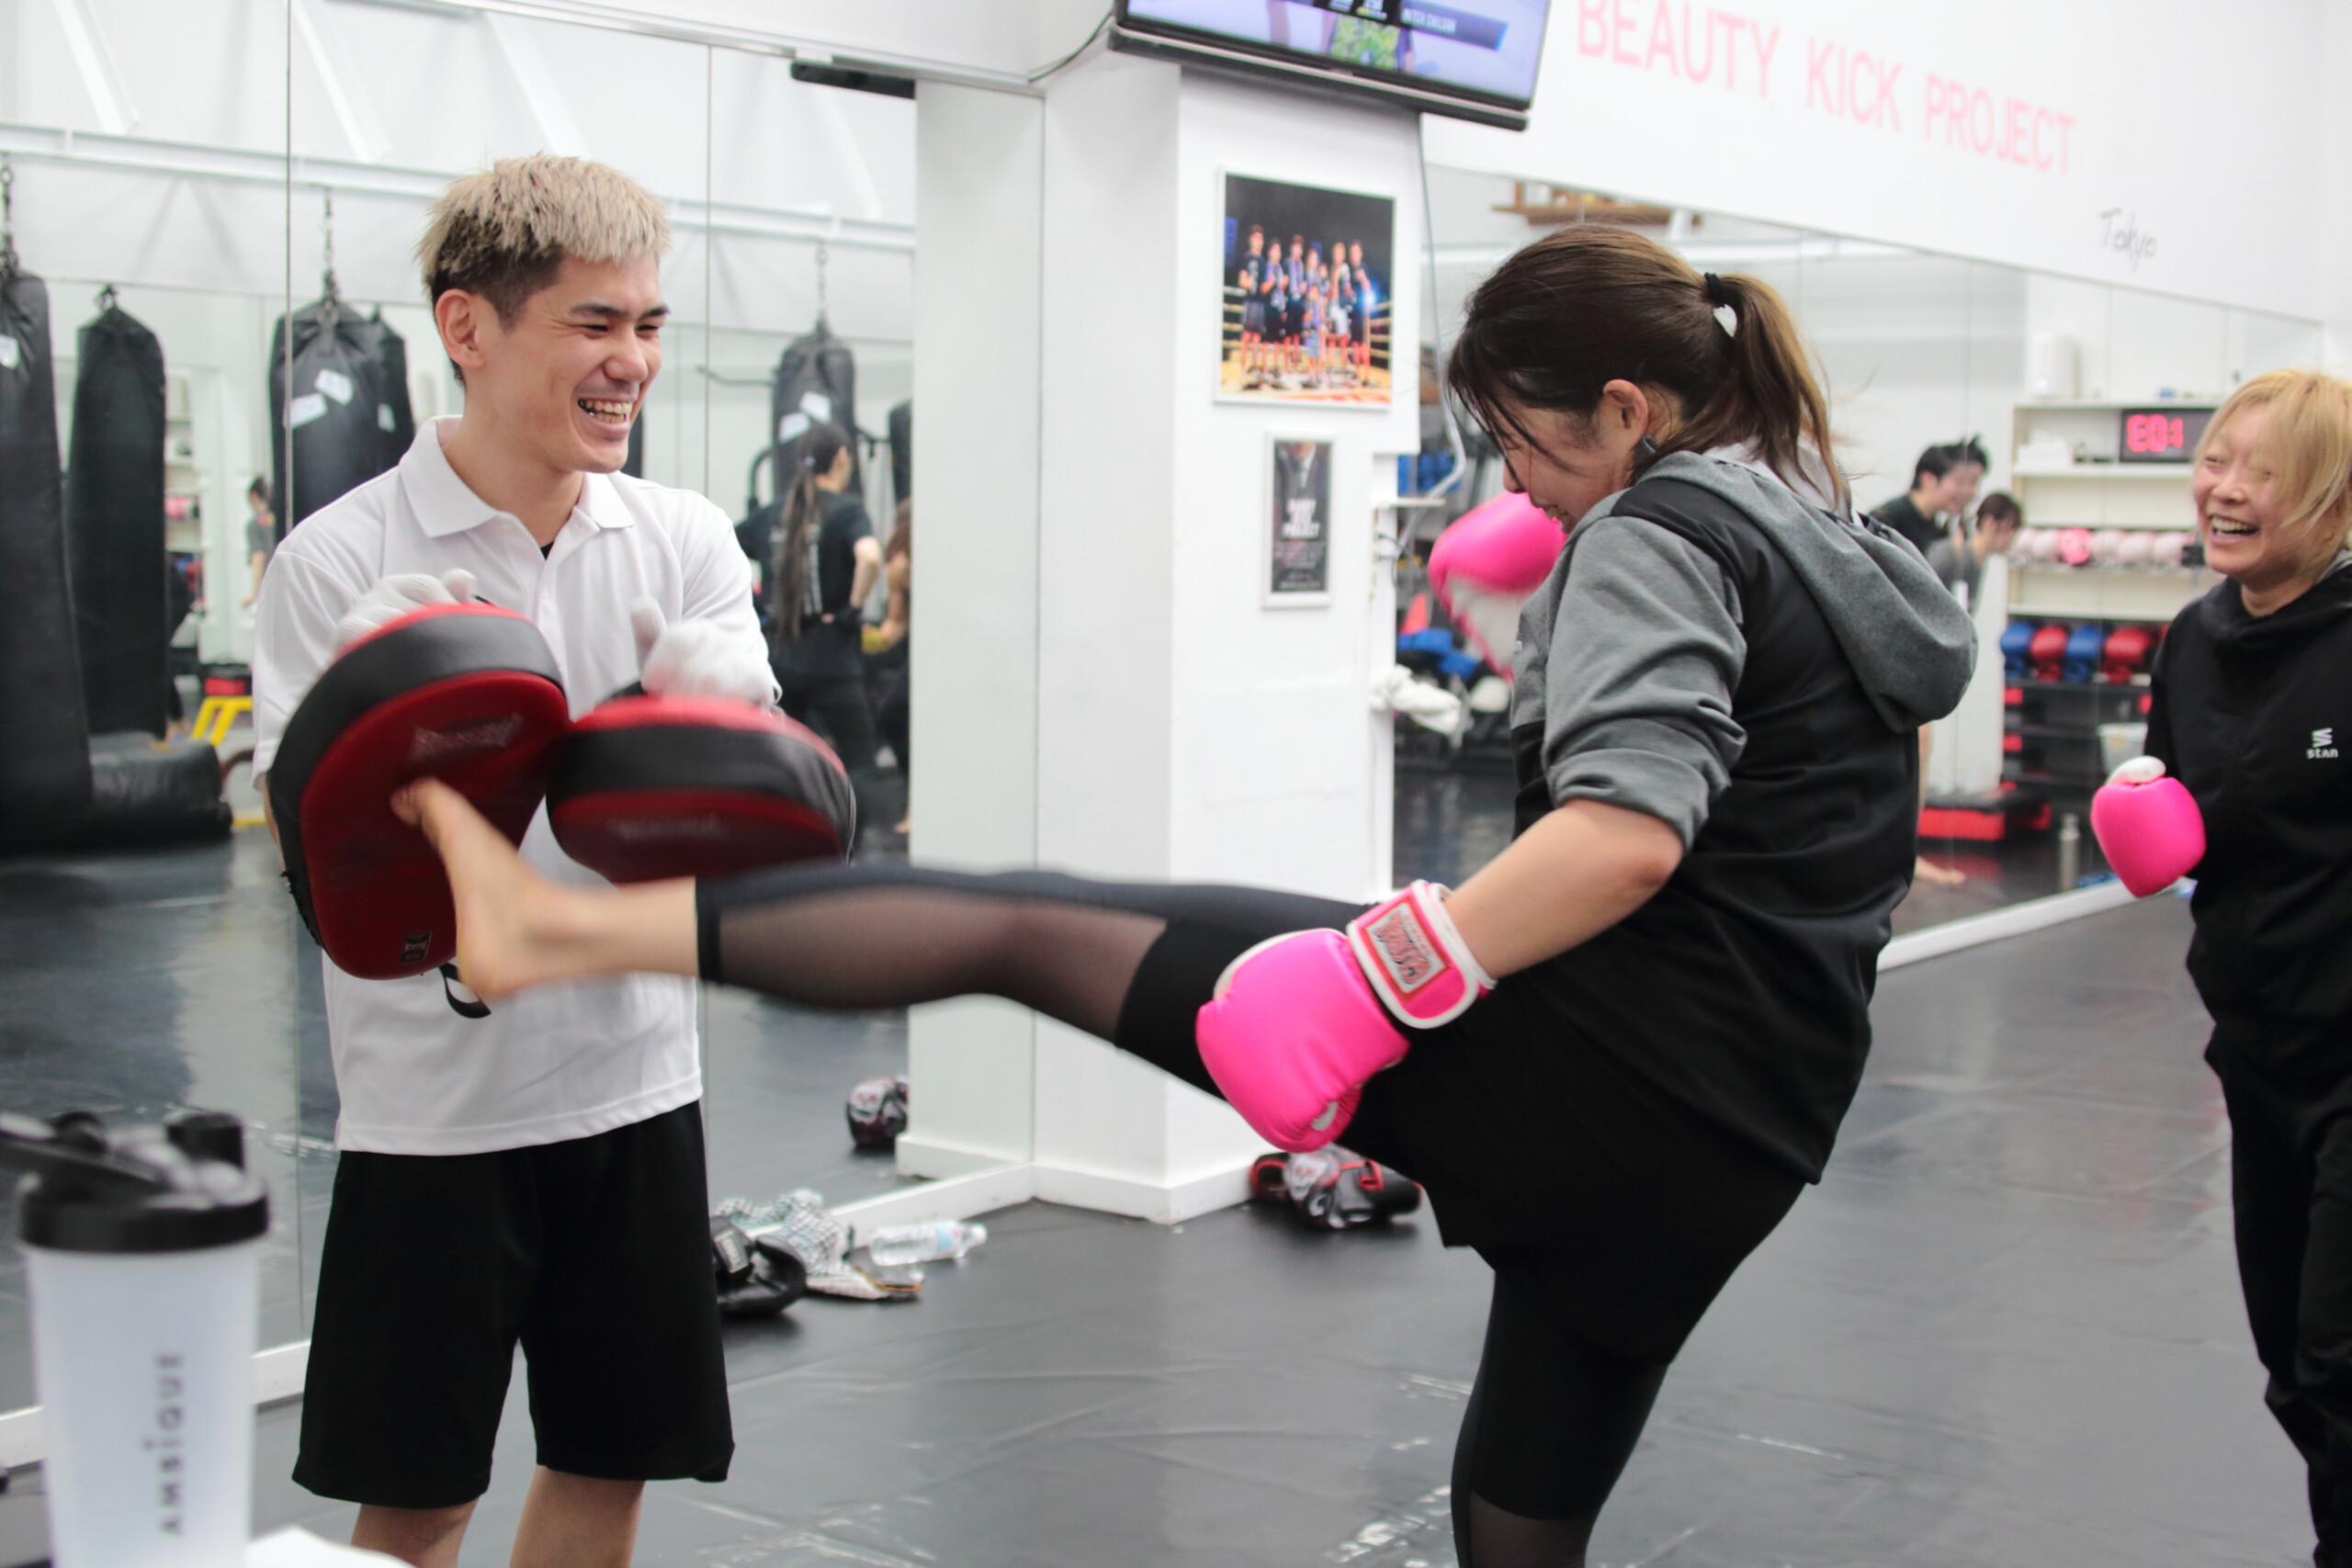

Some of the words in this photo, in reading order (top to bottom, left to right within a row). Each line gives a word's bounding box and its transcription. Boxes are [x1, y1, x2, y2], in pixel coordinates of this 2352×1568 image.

[1578, 0, 1781, 97] BEAUTY
[1806, 37, 1903, 131] KICK
[1925, 73, 2075, 177] PROJECT
[2099, 207, 2157, 272] Tokyo
